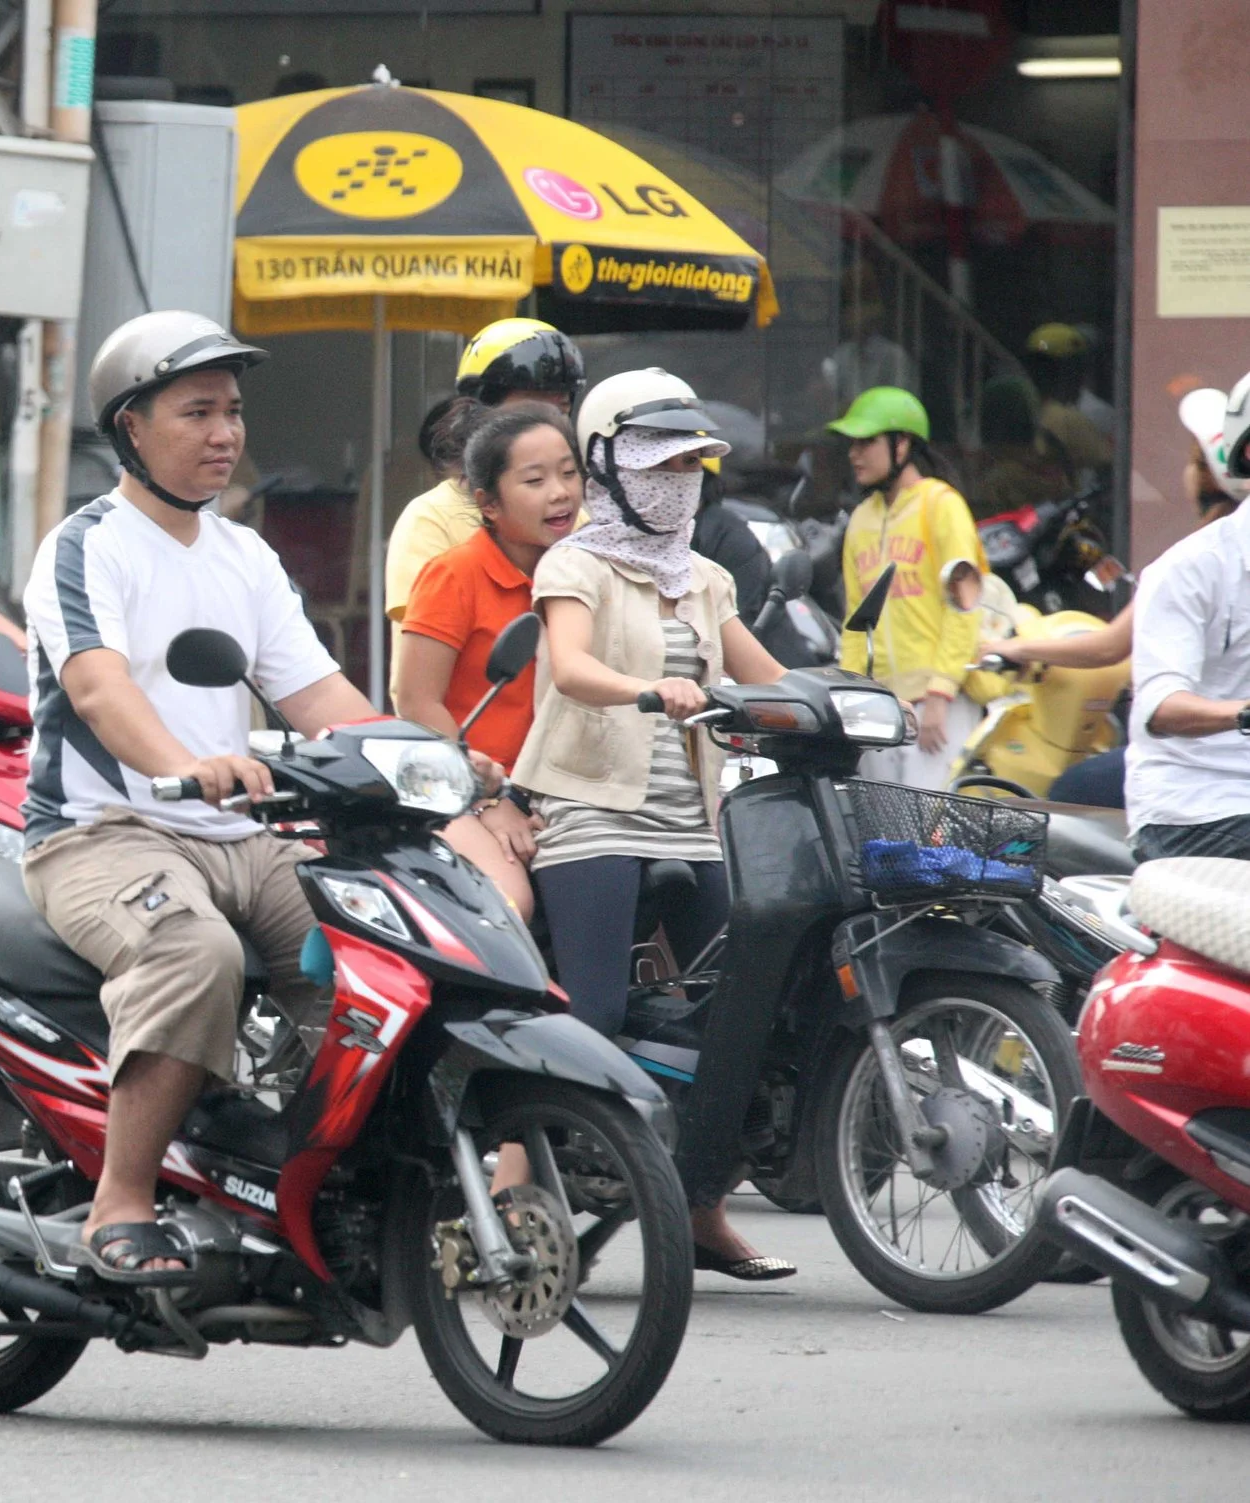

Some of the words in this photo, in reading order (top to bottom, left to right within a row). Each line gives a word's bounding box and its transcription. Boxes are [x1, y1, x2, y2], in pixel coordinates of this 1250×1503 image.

[599, 183, 690, 218] LG
[256, 258, 296, 281] 130
[371, 254, 458, 280] QUANG
[464, 249, 521, 279] KHẢI
[597, 256, 754, 302] thegioididong
